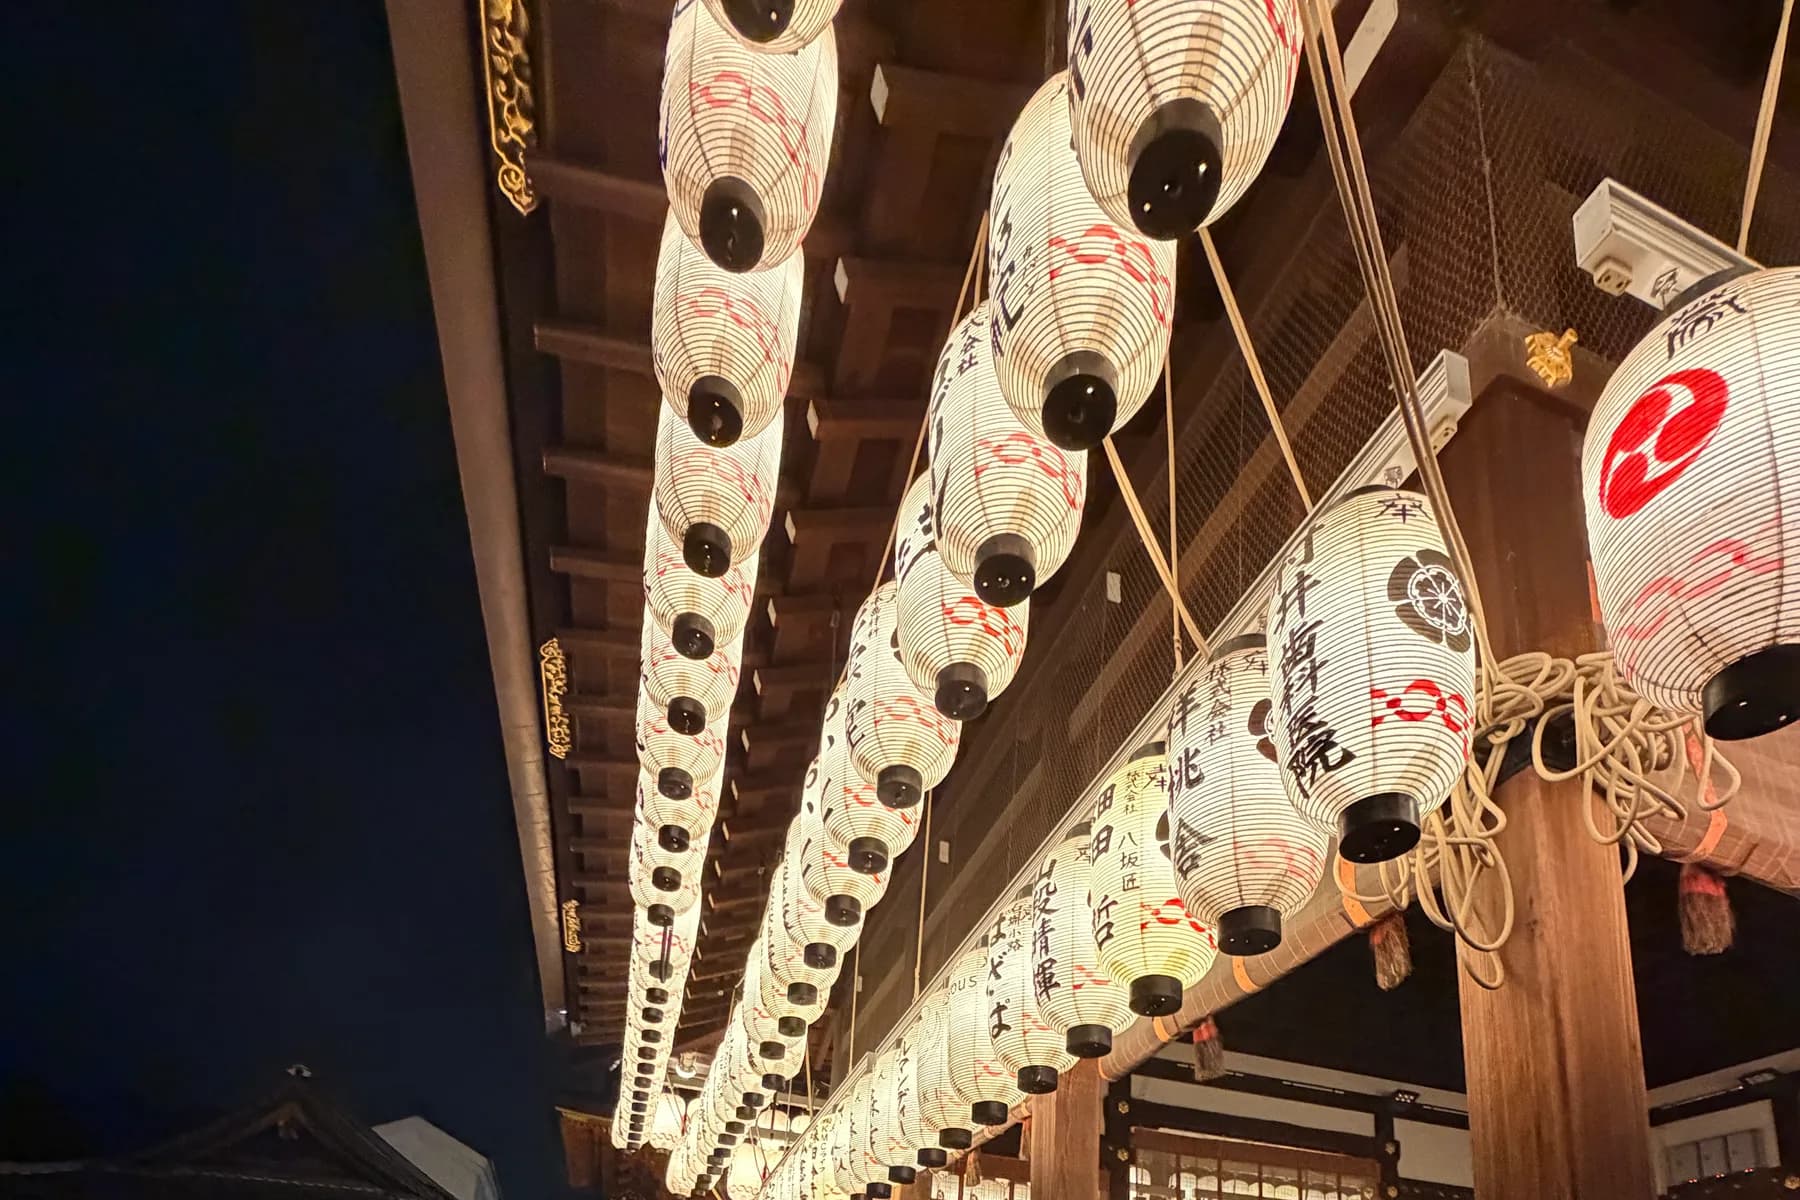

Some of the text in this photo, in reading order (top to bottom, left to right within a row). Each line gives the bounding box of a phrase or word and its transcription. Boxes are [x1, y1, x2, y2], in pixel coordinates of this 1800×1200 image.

[1374, 493, 1433, 525] 奉
[1206, 660, 1232, 747] 株式会社
[1118, 831, 1141, 892] 八坂匠
